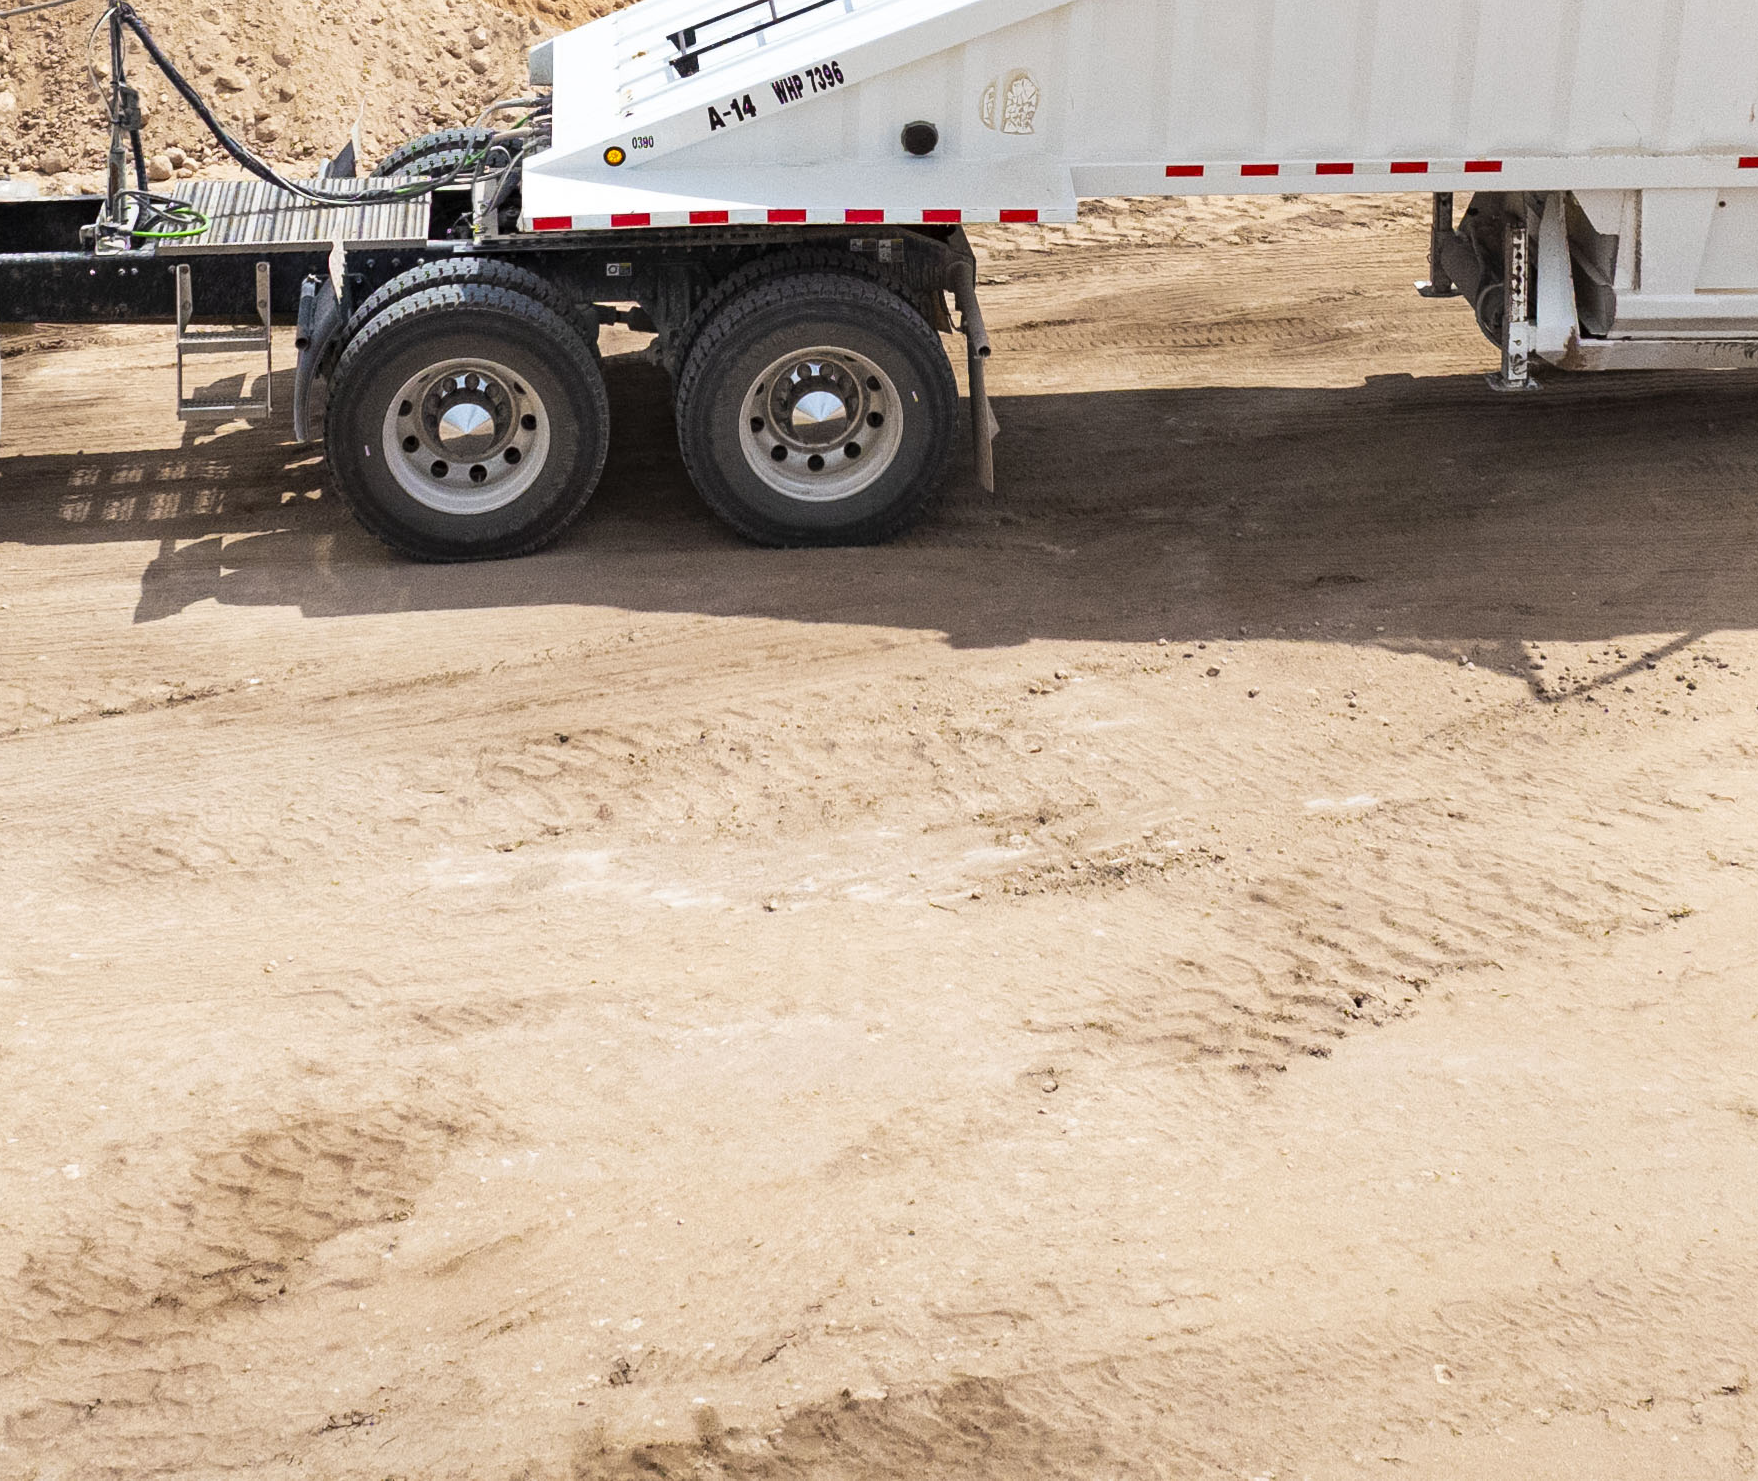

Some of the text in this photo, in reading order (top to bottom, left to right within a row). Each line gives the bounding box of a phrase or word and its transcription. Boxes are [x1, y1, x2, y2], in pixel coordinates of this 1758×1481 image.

[771, 60, 845, 105] WHP 7396
[707, 93, 757, 131] A-14
